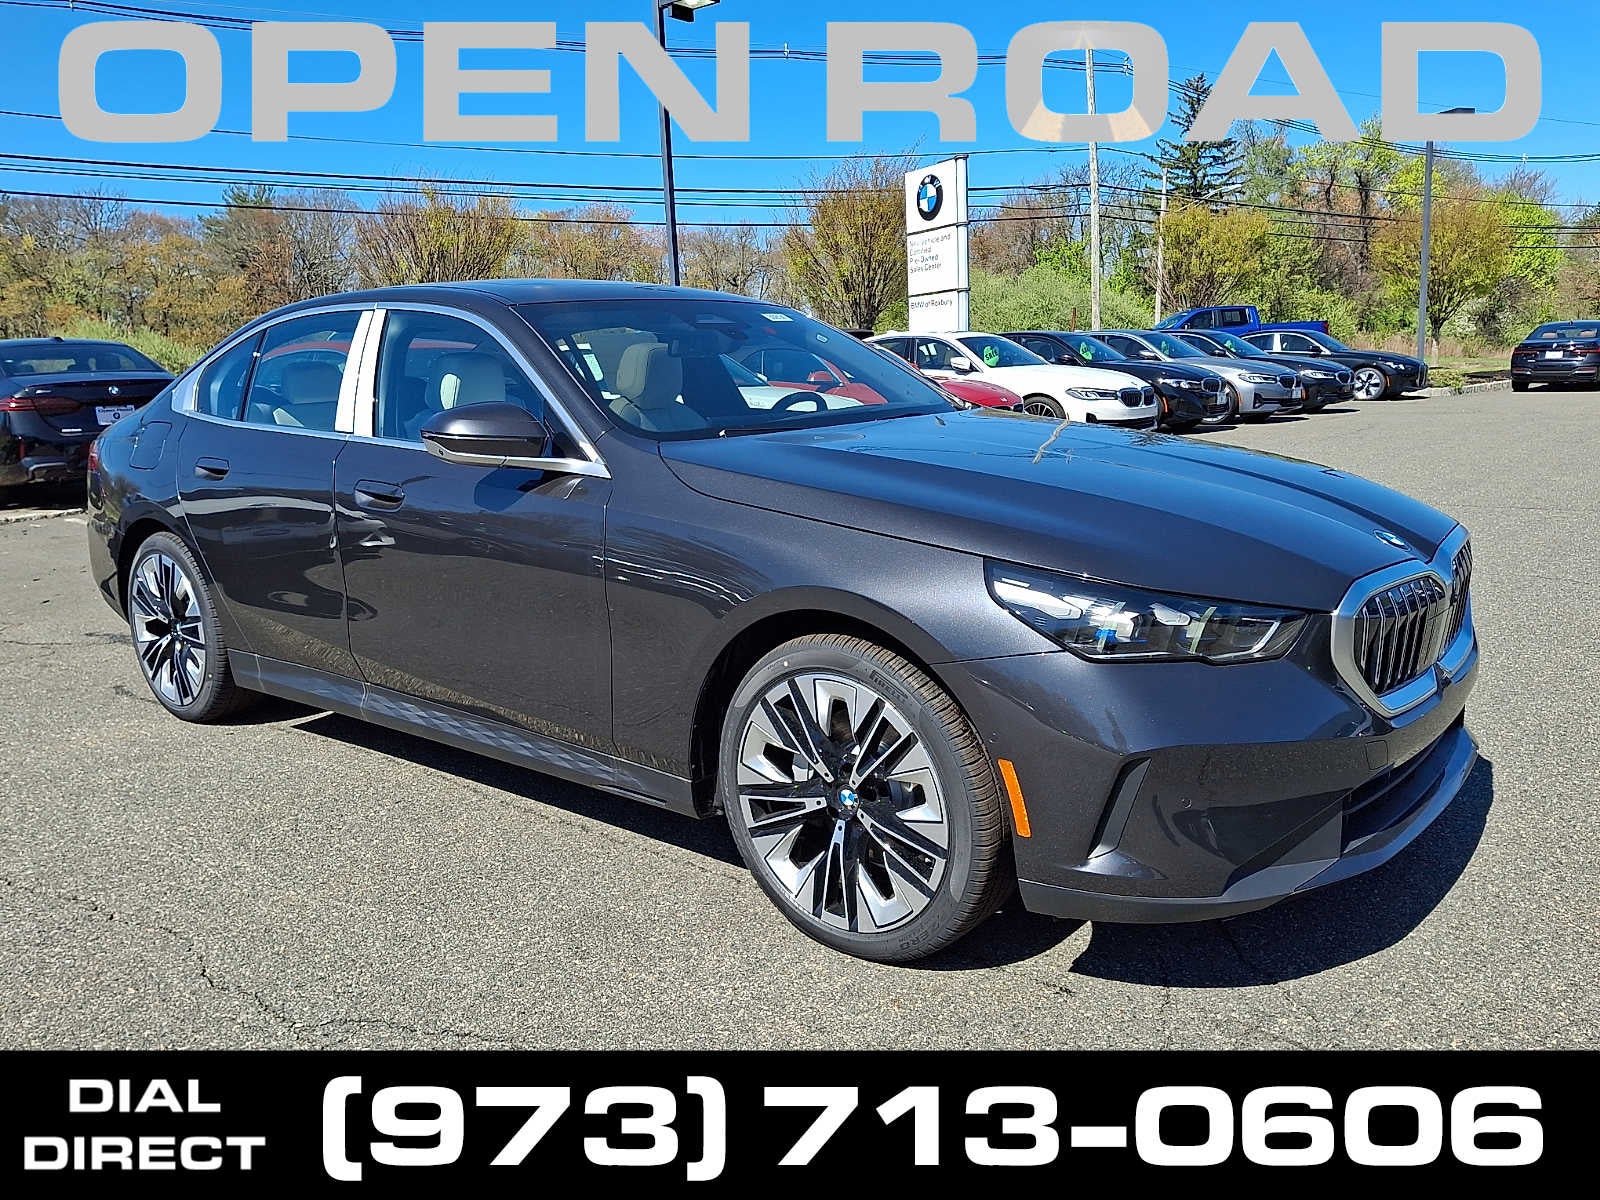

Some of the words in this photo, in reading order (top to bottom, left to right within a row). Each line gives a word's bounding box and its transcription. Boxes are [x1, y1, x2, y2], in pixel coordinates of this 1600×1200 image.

[940, 233, 951, 242] and
[910, 302, 925, 310] BMW
[985, 349, 1000, 362] SALE
